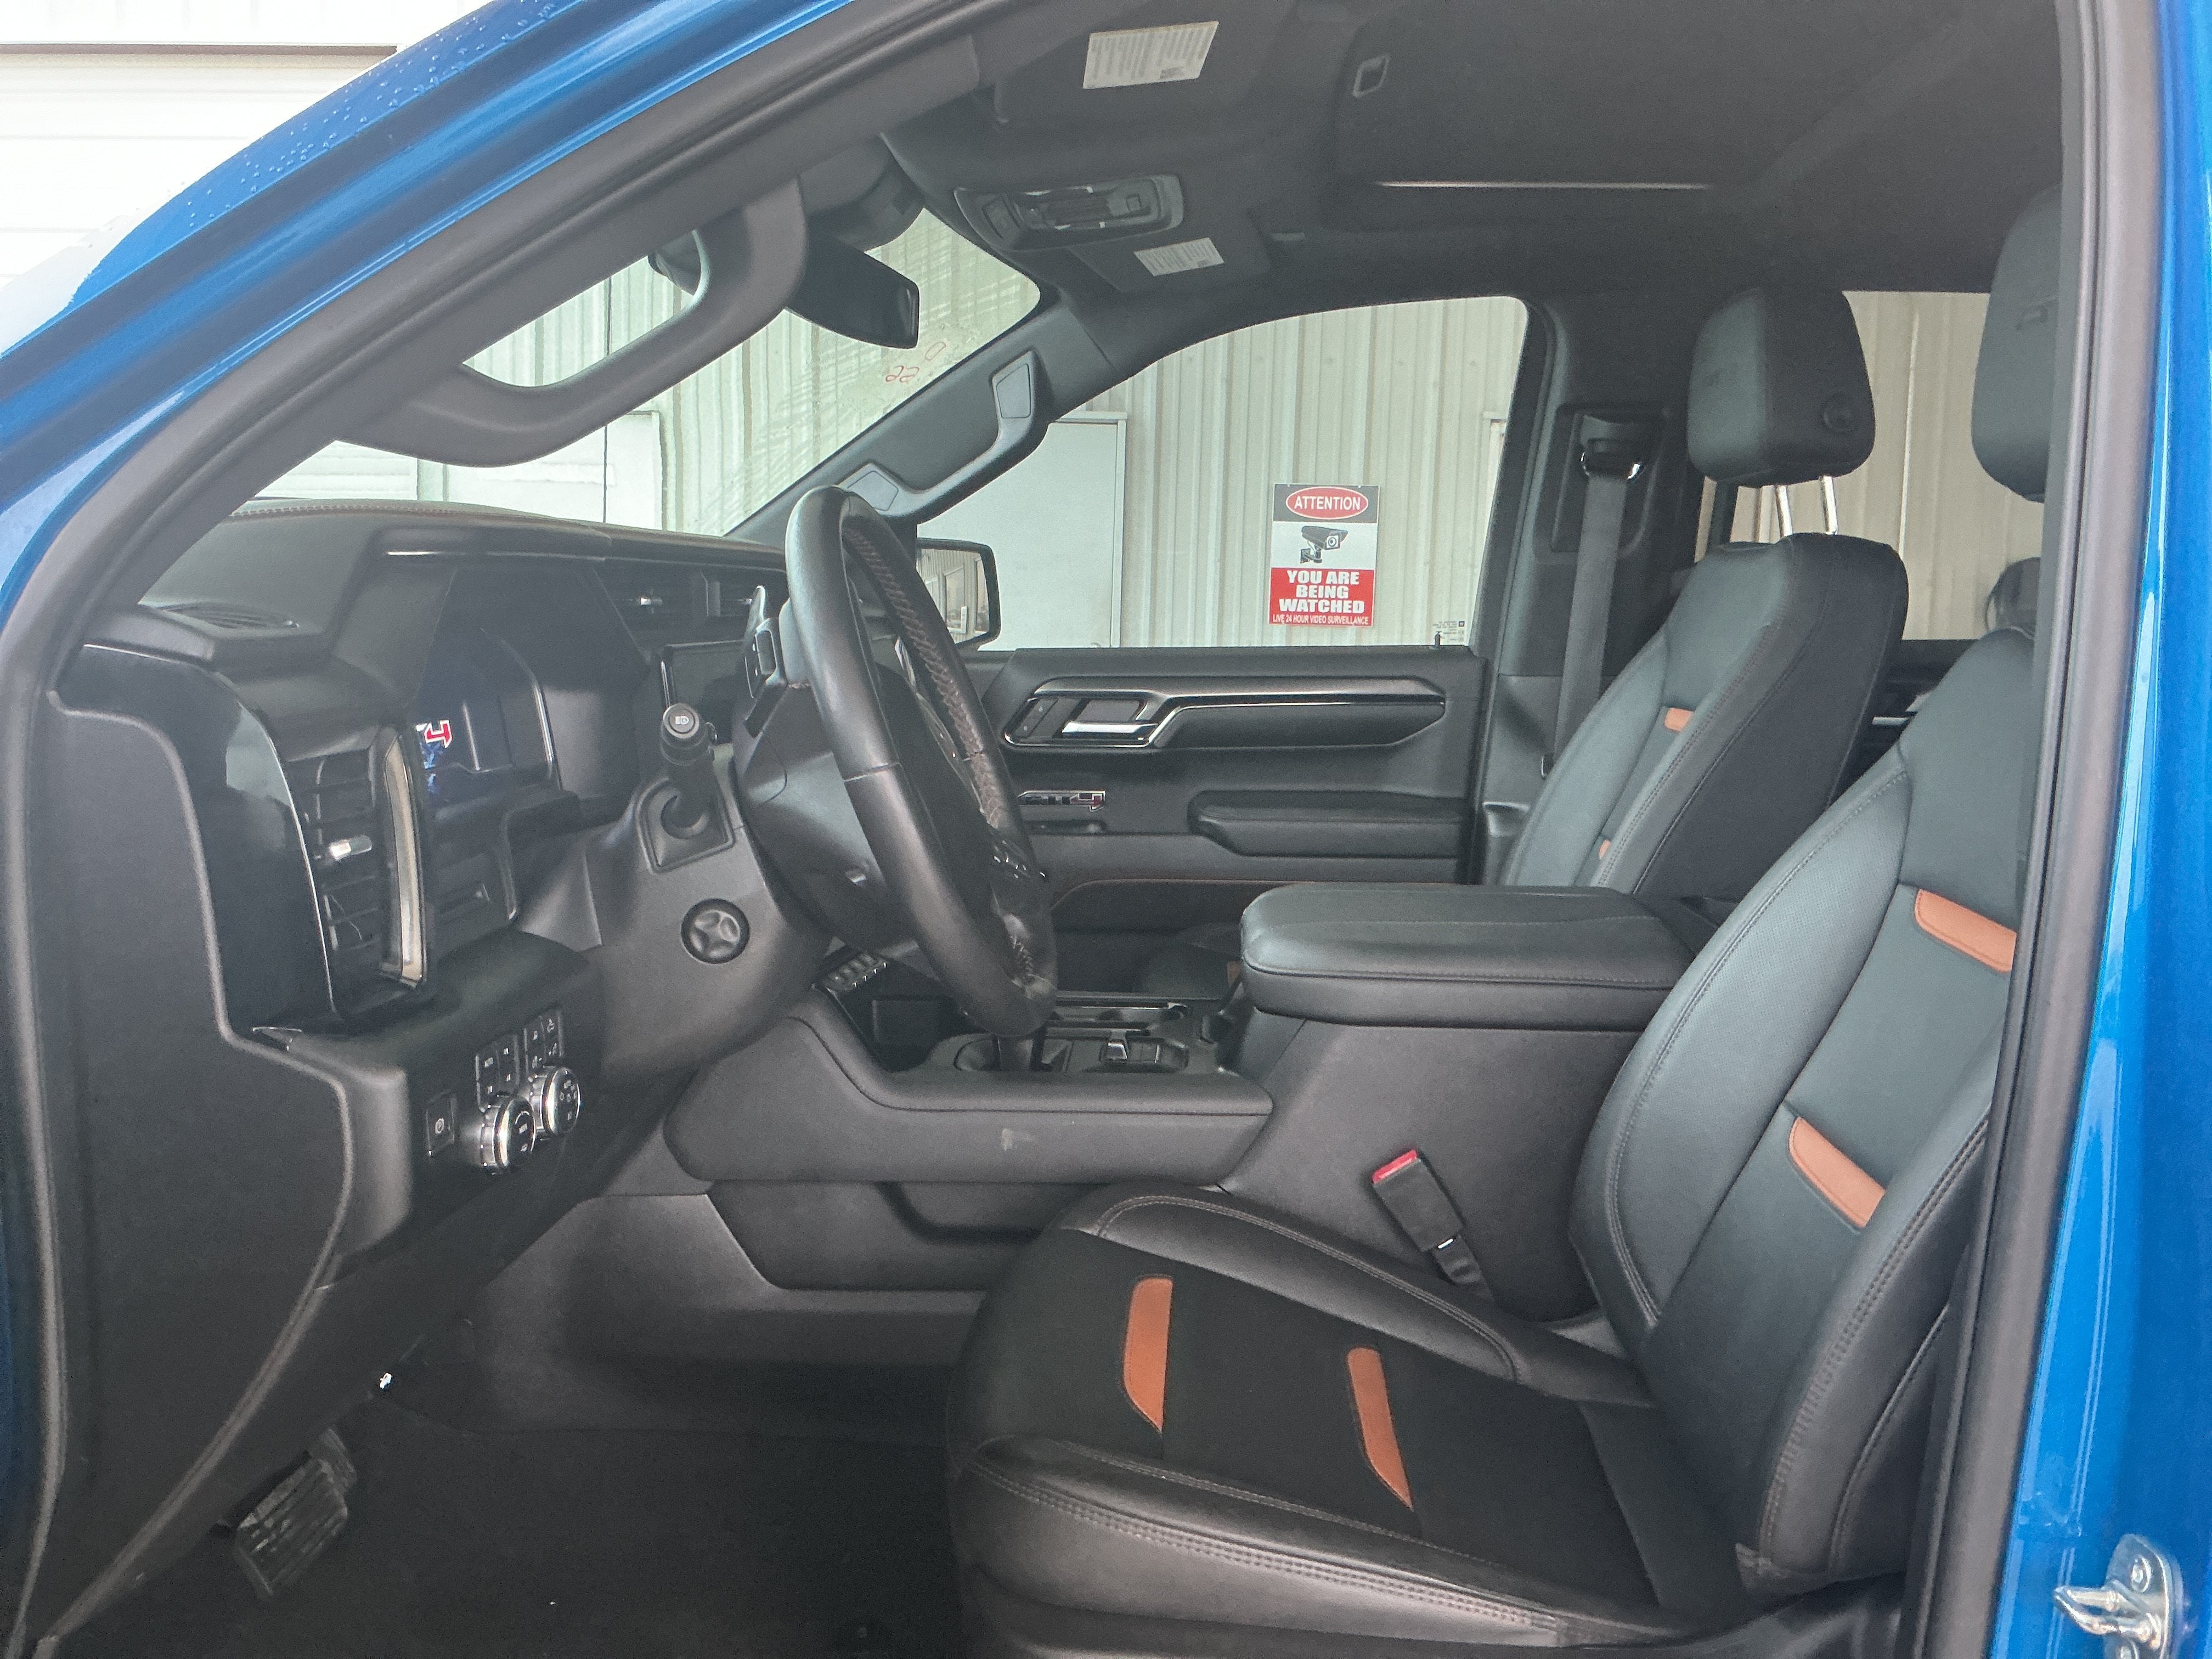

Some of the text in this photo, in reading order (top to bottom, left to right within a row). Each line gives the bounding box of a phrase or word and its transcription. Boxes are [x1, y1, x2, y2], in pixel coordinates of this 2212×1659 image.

[1294, 495, 1361, 511] ATTENTION
[1286, 570, 1360, 585] YOU ARE
[1296, 584, 1349, 599] BEING
[1278, 598, 1365, 614] WATCHED
[1272, 614, 1369, 625] LIVE 24 HOUR VIDEO SURVEILLANCE
